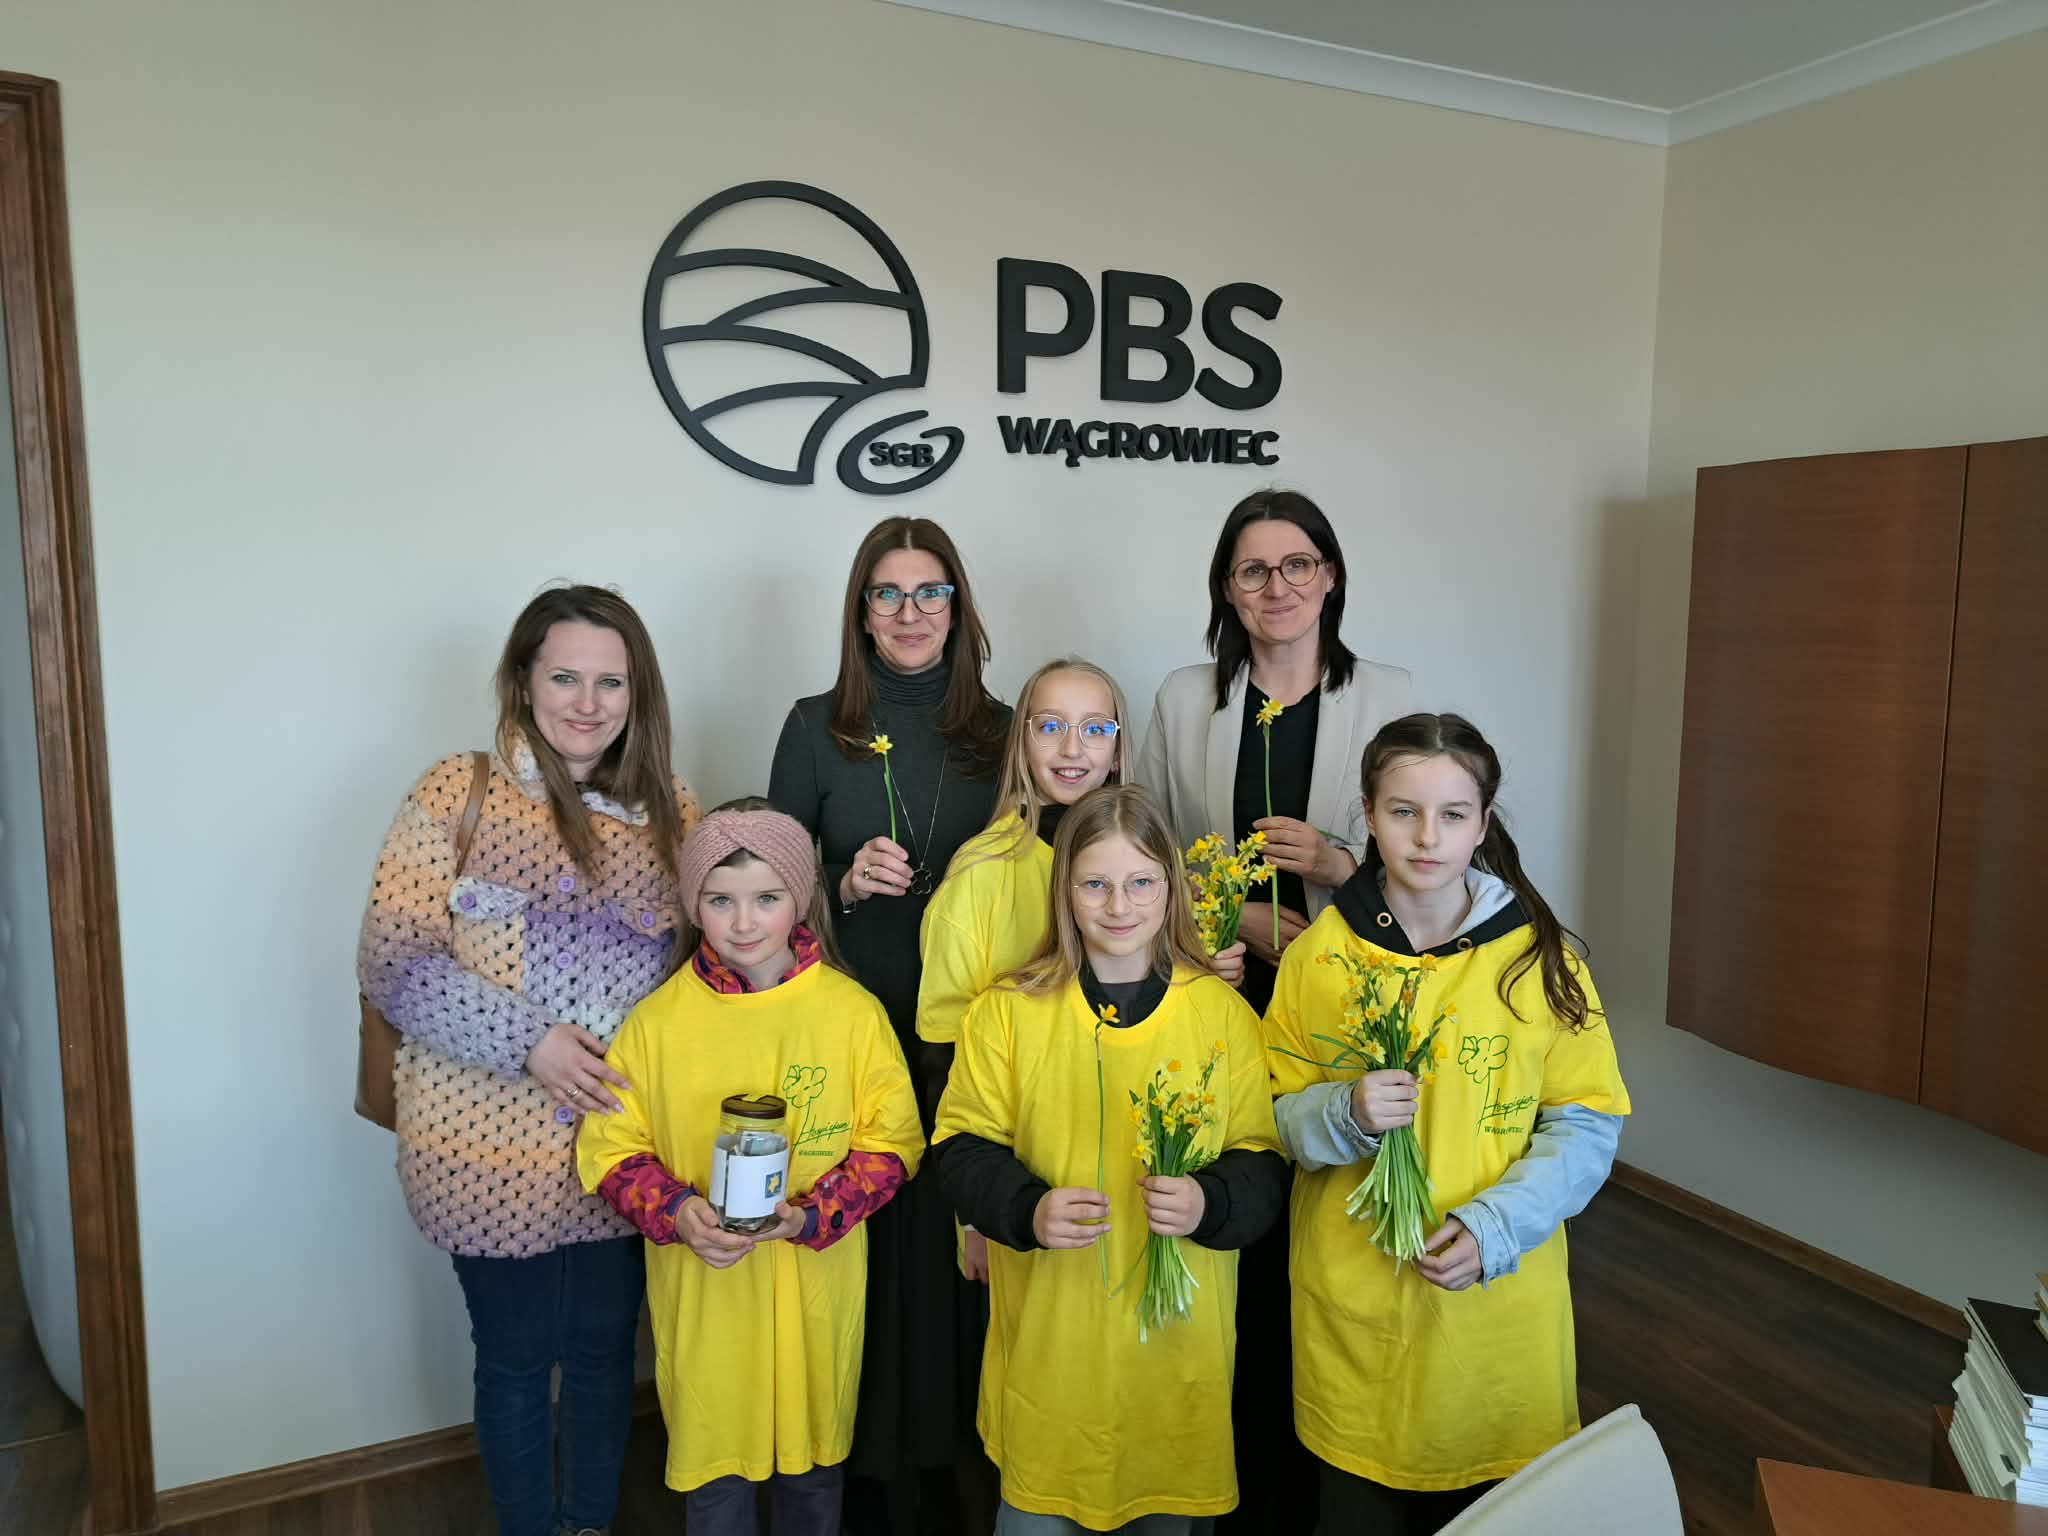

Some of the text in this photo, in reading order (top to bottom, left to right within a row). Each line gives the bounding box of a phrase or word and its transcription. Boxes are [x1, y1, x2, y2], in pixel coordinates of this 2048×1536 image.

[997, 257, 1283, 410] PBS
[869, 441, 935, 467] SGB
[997, 416, 1280, 467] WĄGROWIEC
